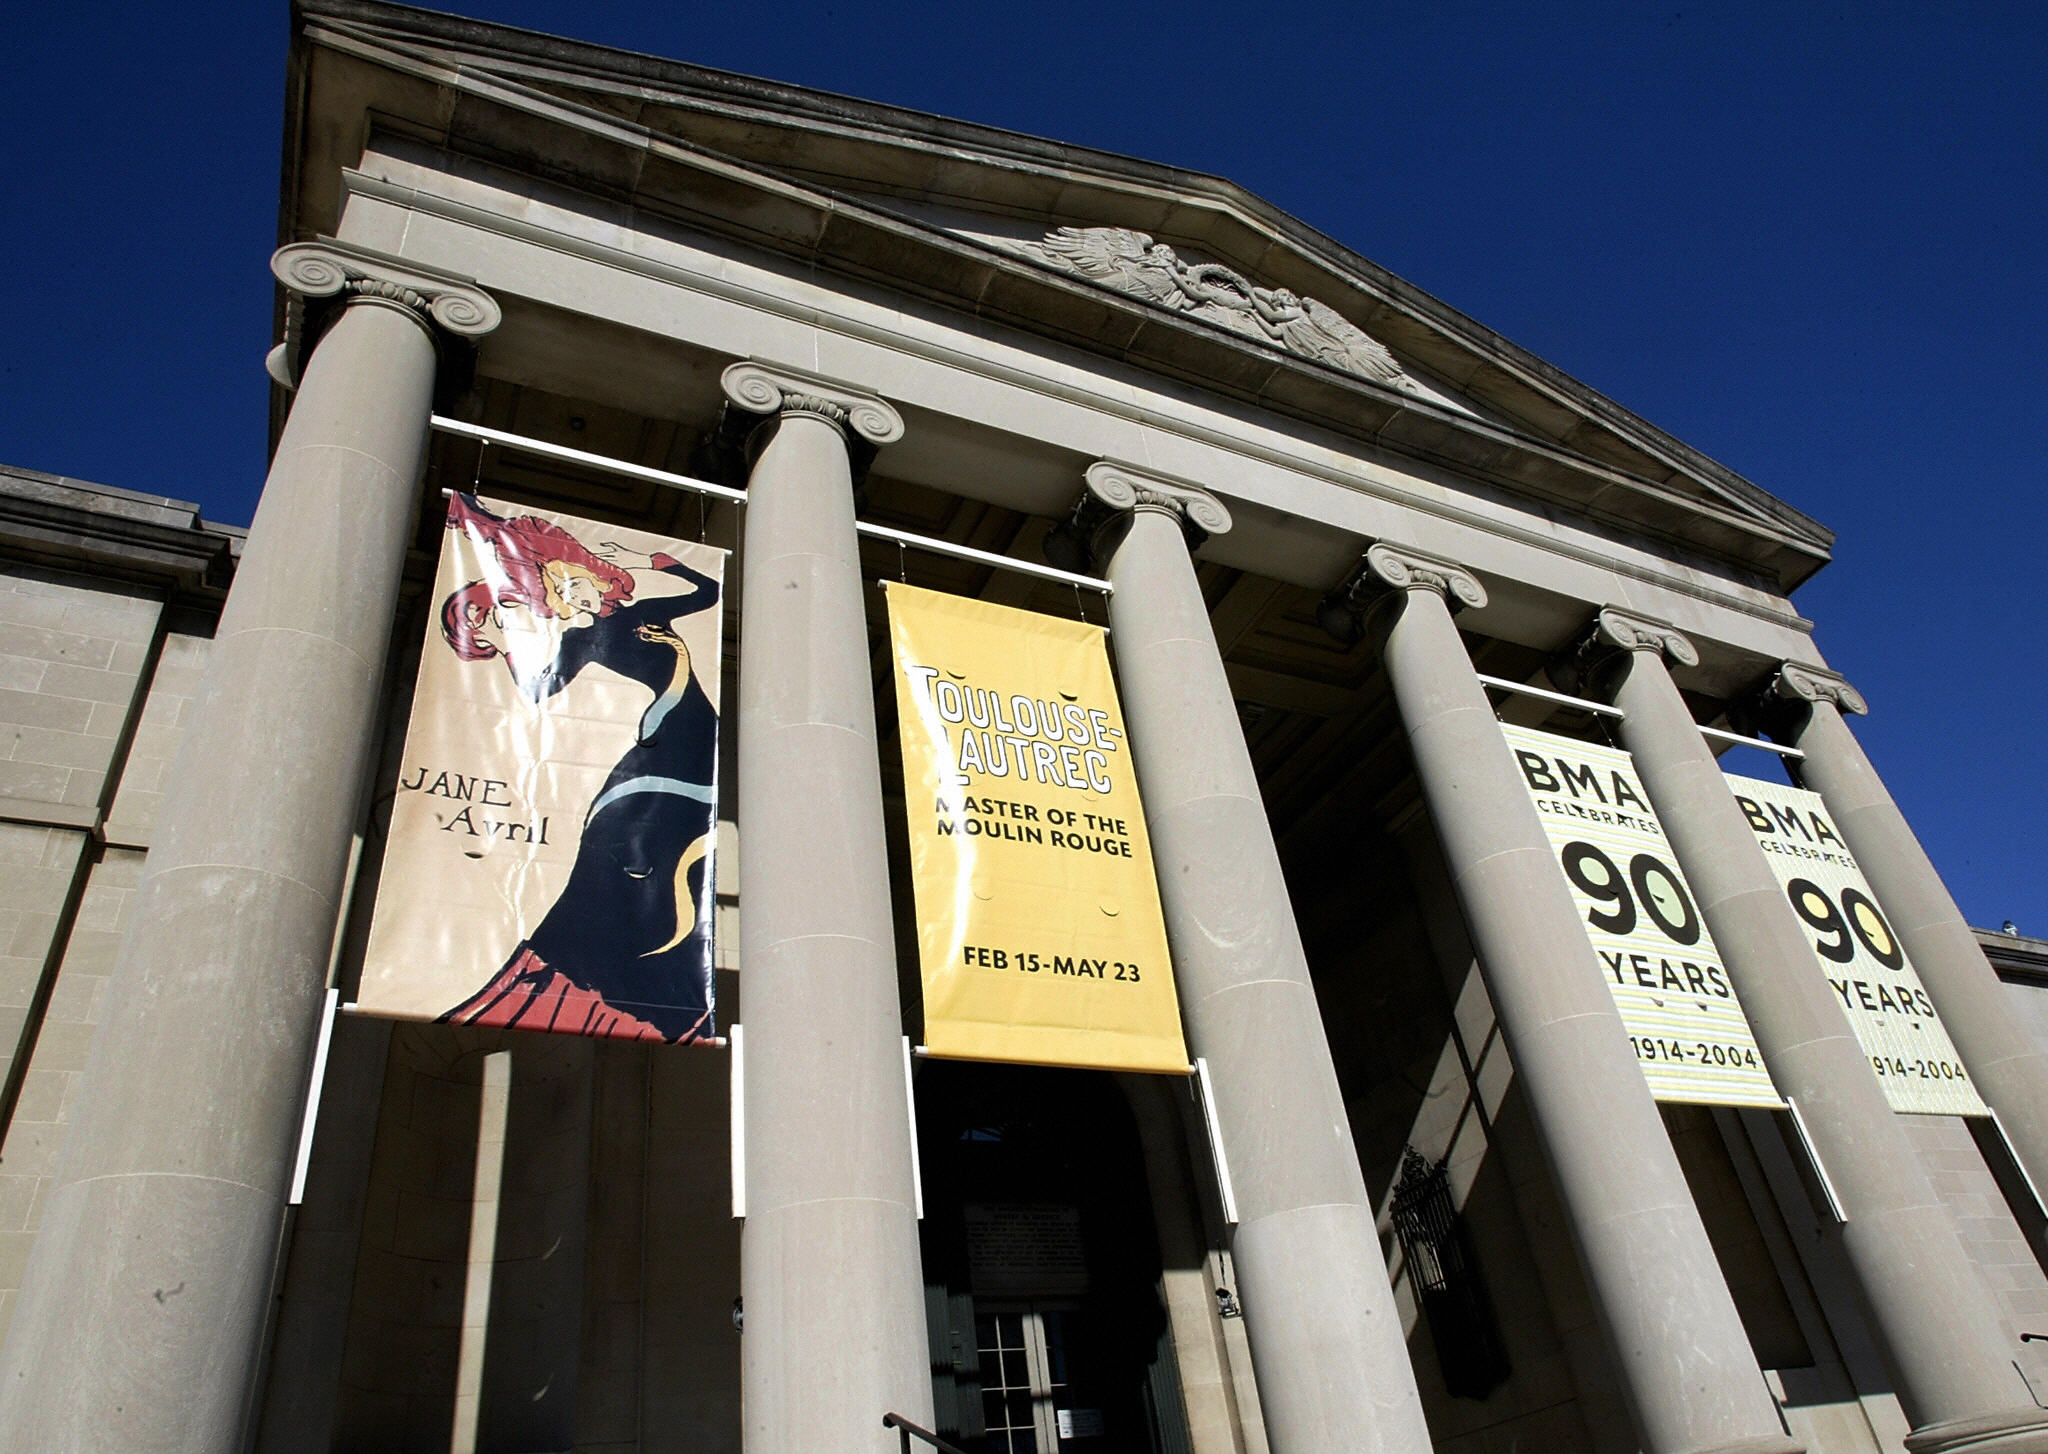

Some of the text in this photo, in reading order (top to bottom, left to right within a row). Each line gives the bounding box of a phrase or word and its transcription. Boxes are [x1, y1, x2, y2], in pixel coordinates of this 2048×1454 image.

[904, 665, 1123, 751] TOULOUSE-
[938, 725, 1112, 794] LAUTREC
[401, 767, 512, 807] JANE
[1514, 749, 1650, 813] BMA
[440, 806, 550, 845] Avril
[1047, 808, 1078, 826] OF
[1083, 813, 1129, 836] THE
[1537, 799, 1660, 835] CELEBRATES
[1733, 794, 1846, 850] BMA
[937, 818, 1133, 858] MOULIN ROUGE
[1760, 839, 1857, 869] CELEBRATES
[1560, 840, 1701, 946] 90
[1786, 877, 1905, 971] 90
[963, 946, 1141, 982] FEB 15-MAY 23
[1597, 950, 1730, 999] YEARS
[1827, 978, 1934, 1018] YEARS
[1629, 1036, 1757, 1069] 1914-2004
[1866, 1055, 1966, 1081] 914-2004
